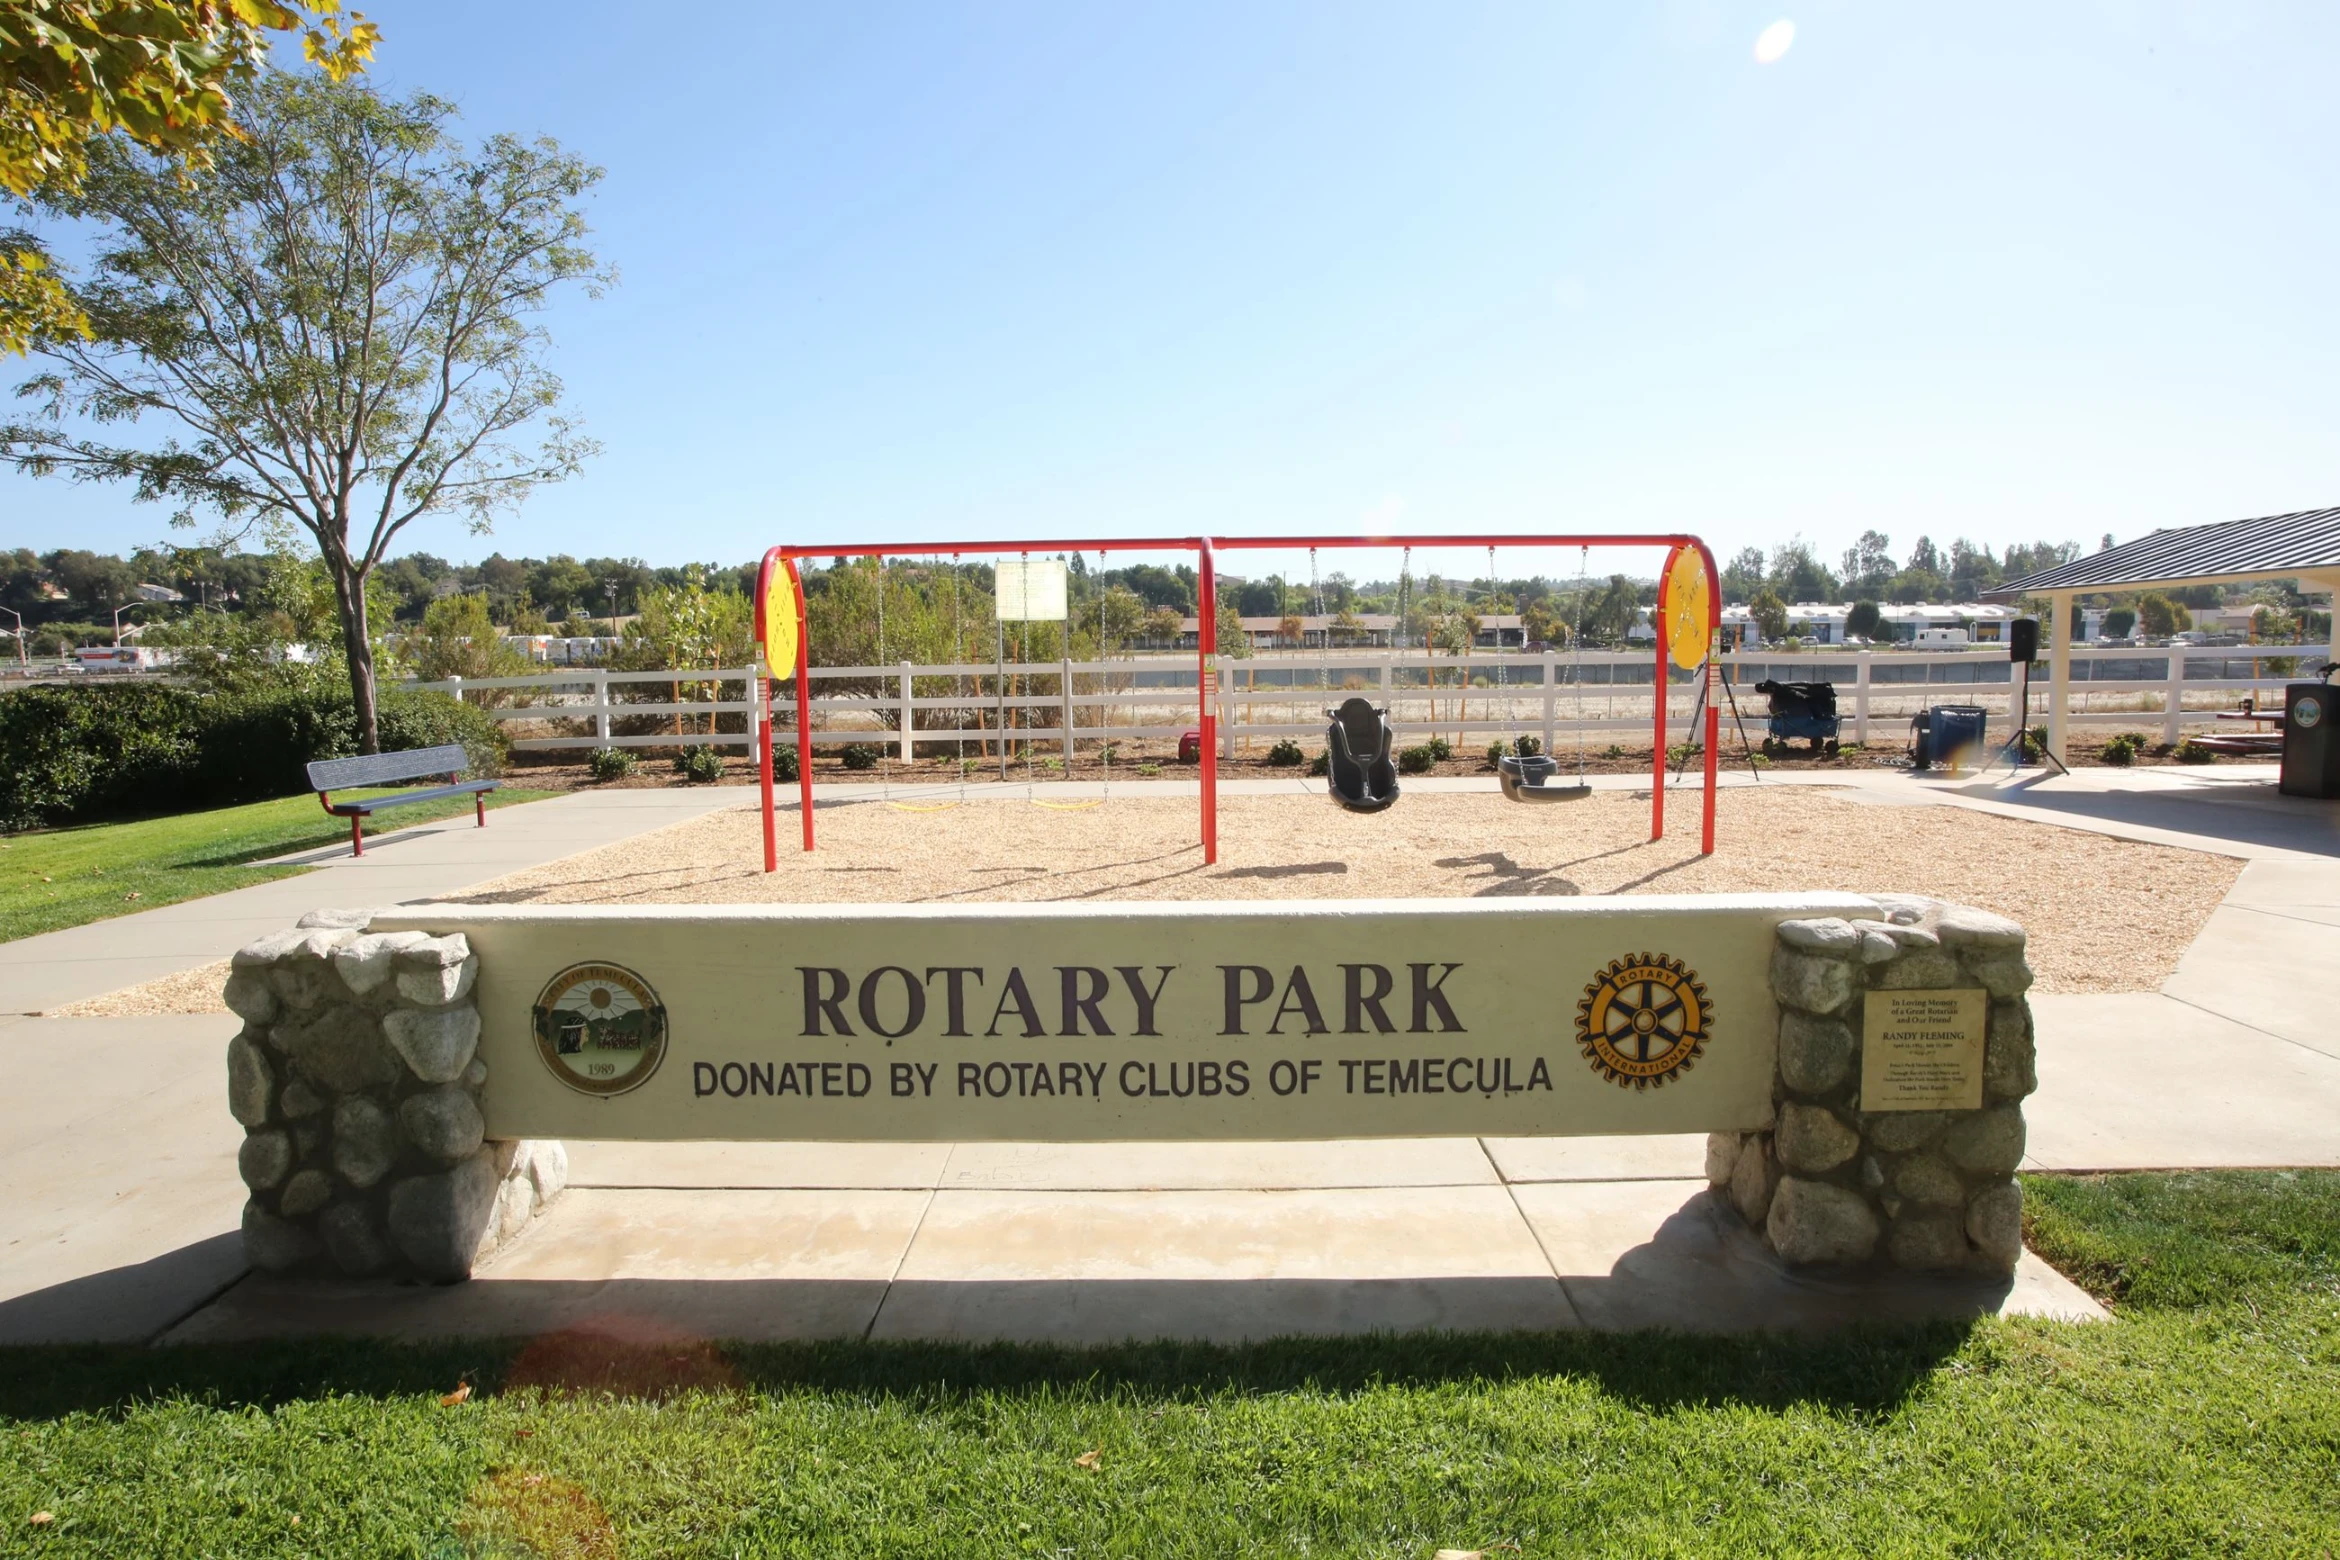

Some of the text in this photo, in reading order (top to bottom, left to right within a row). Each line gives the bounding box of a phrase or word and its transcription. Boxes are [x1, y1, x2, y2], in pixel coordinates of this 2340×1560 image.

[549, 968, 646, 998] CITY OF TEMECULA
[1620, 970, 1672, 984] ROTARY
[797, 963, 1467, 1036] ROTARY PARK
[1902, 999, 1926, 1007] Loving
[1928, 999, 1958, 1007] Memory
[1883, 1031, 1965, 1040] RANDY FLEMING
[1599, 1042, 1690, 1073] INTERNATIONAL
[588, 1064, 614, 1075] 1989
[694, 1062, 871, 1097] DONATED
[891, 1063, 937, 1097] BY
[957, 1062, 1107, 1097] ROTARY
[1119, 1061, 1250, 1096] CLUBS
[1269, 1060, 1322, 1095] OF
[1339, 1057, 1553, 1094] TEMECULA
